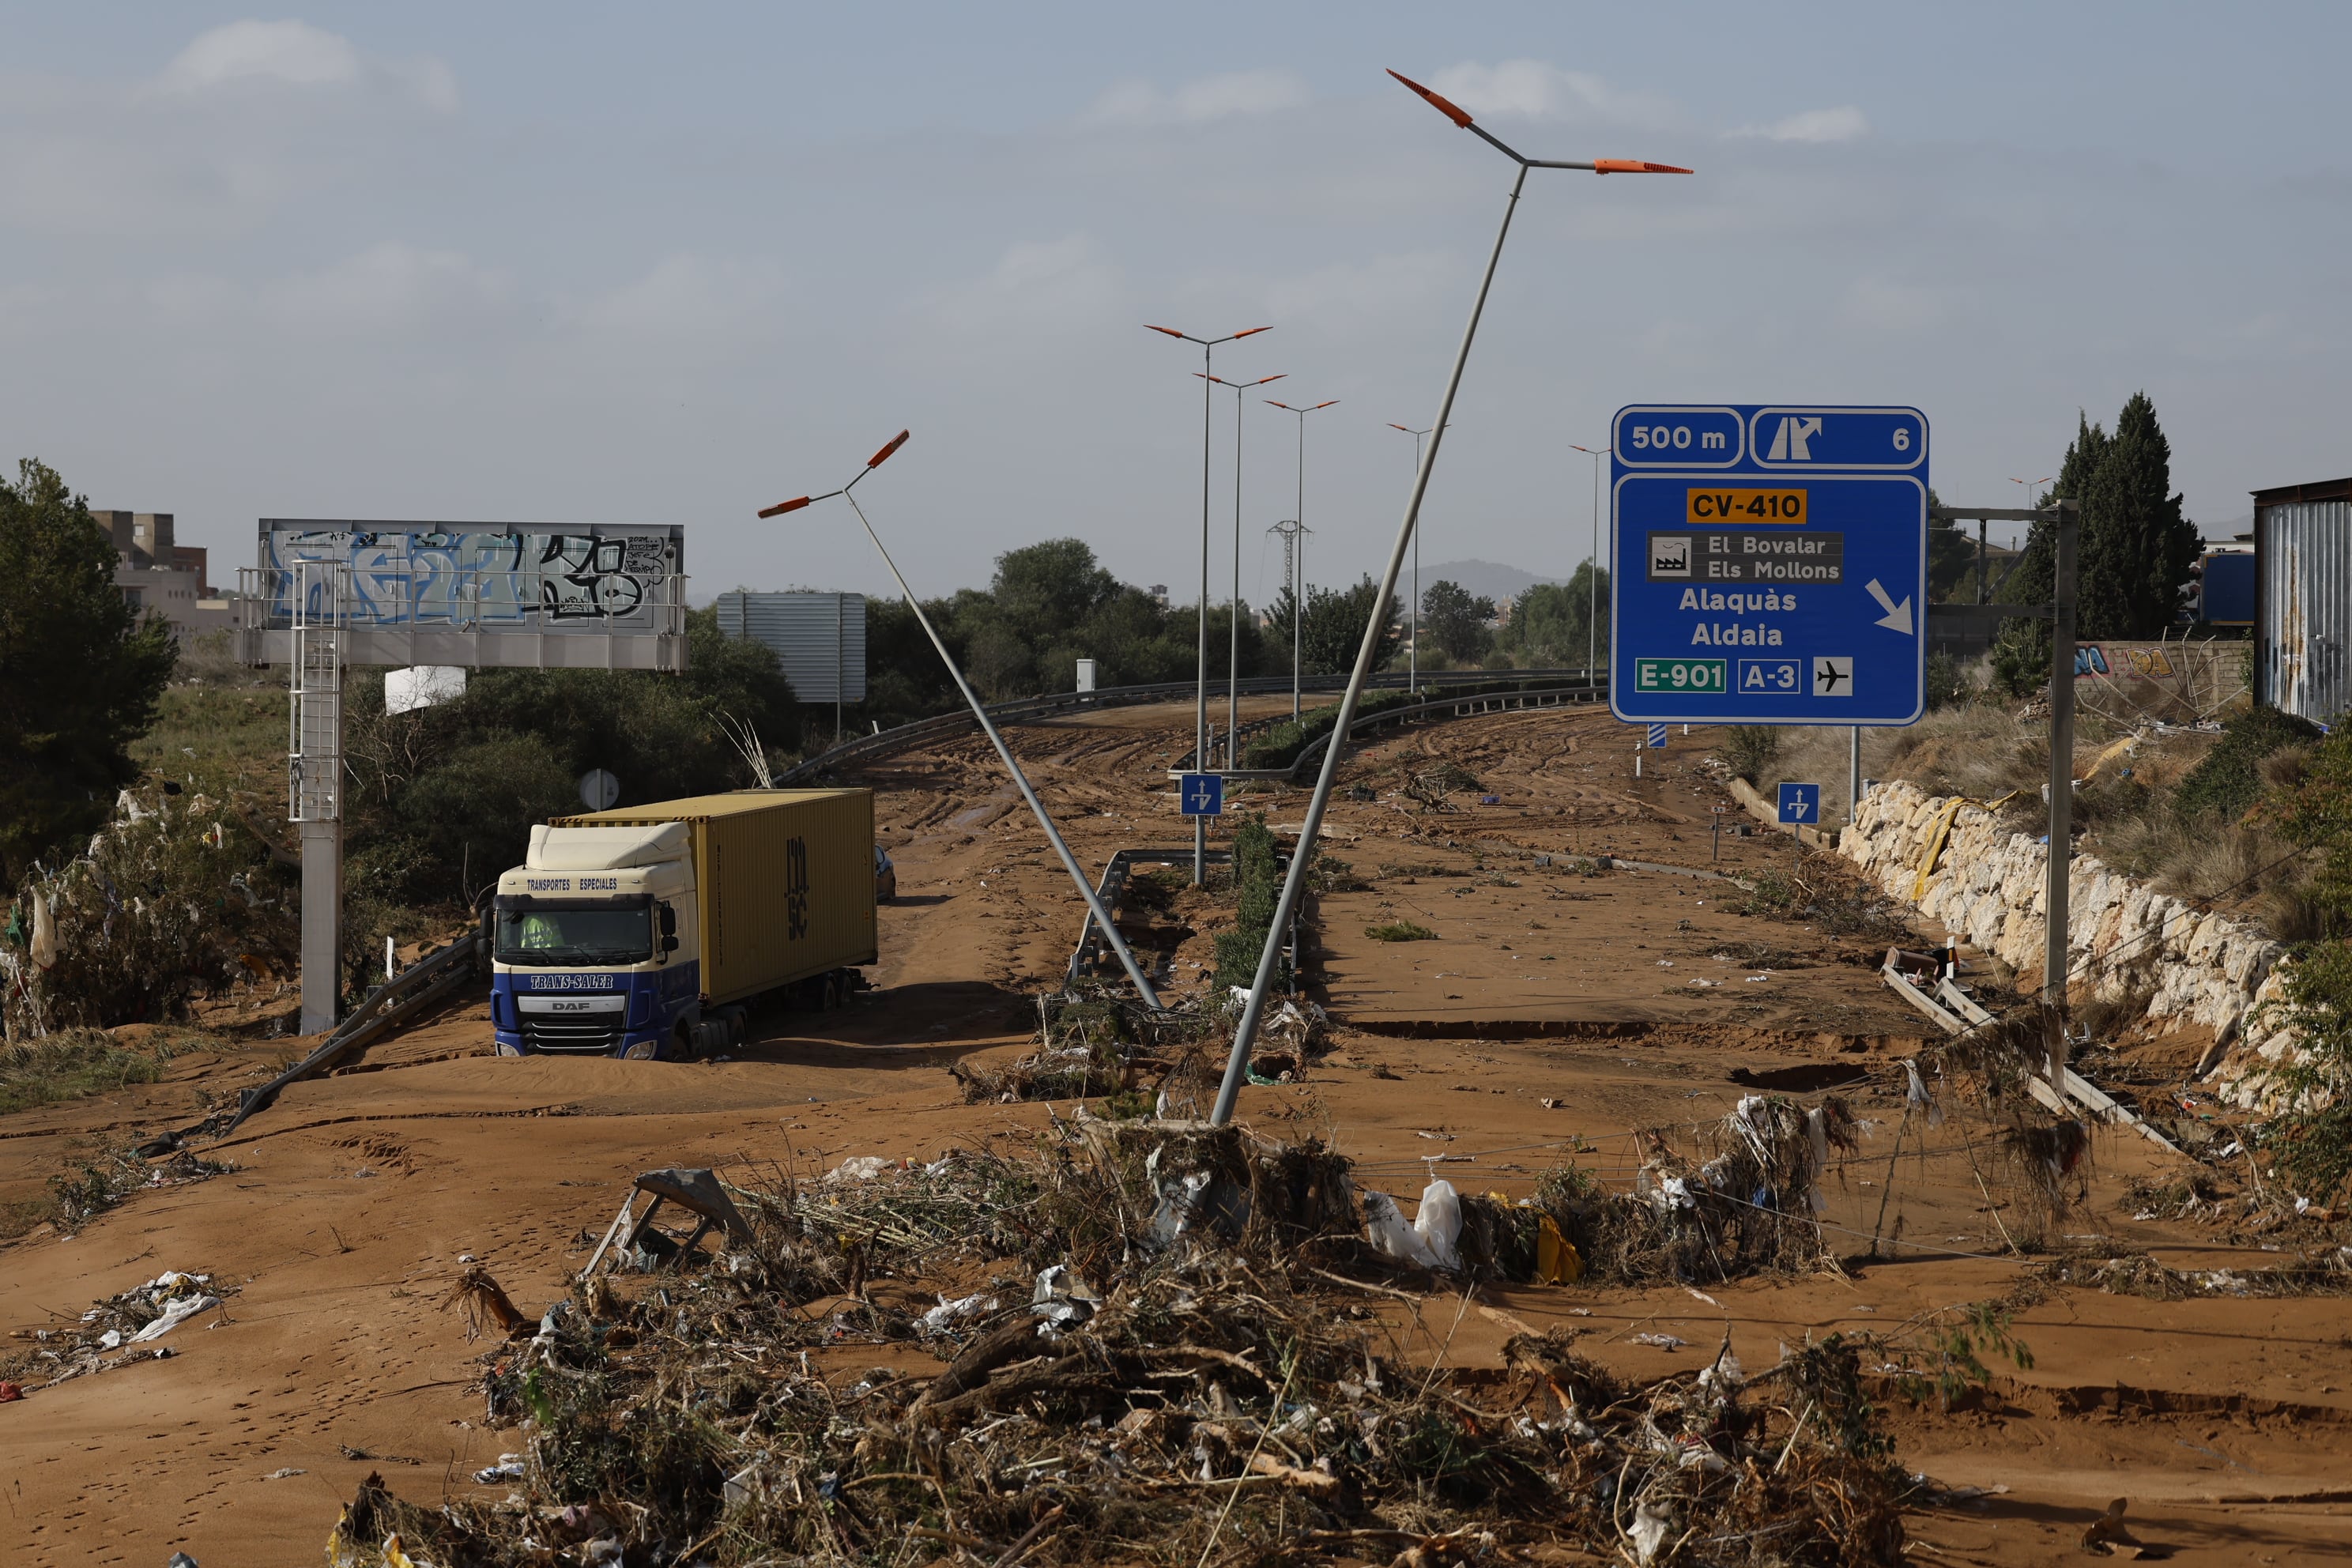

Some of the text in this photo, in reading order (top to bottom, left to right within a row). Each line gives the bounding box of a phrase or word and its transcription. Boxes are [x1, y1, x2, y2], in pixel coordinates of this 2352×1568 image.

[1632, 426, 1726, 449] 500 m
[1892, 428, 1910, 451] 6
[1693, 495, 1800, 517] CV-410
[1709, 536, 1826, 554] El Bovalar
[1709, 561, 1840, 579] Els Mollons
[1679, 587, 1796, 615] Alaquàs
[1690, 623, 1783, 646] Aldaia
[1641, 664, 1722, 688] E-901
[1744, 665, 1795, 688] A-3
[527, 877, 617, 891] TRANSPORTES ESPECIALES
[530, 975, 613, 989] TRANS-SALER
